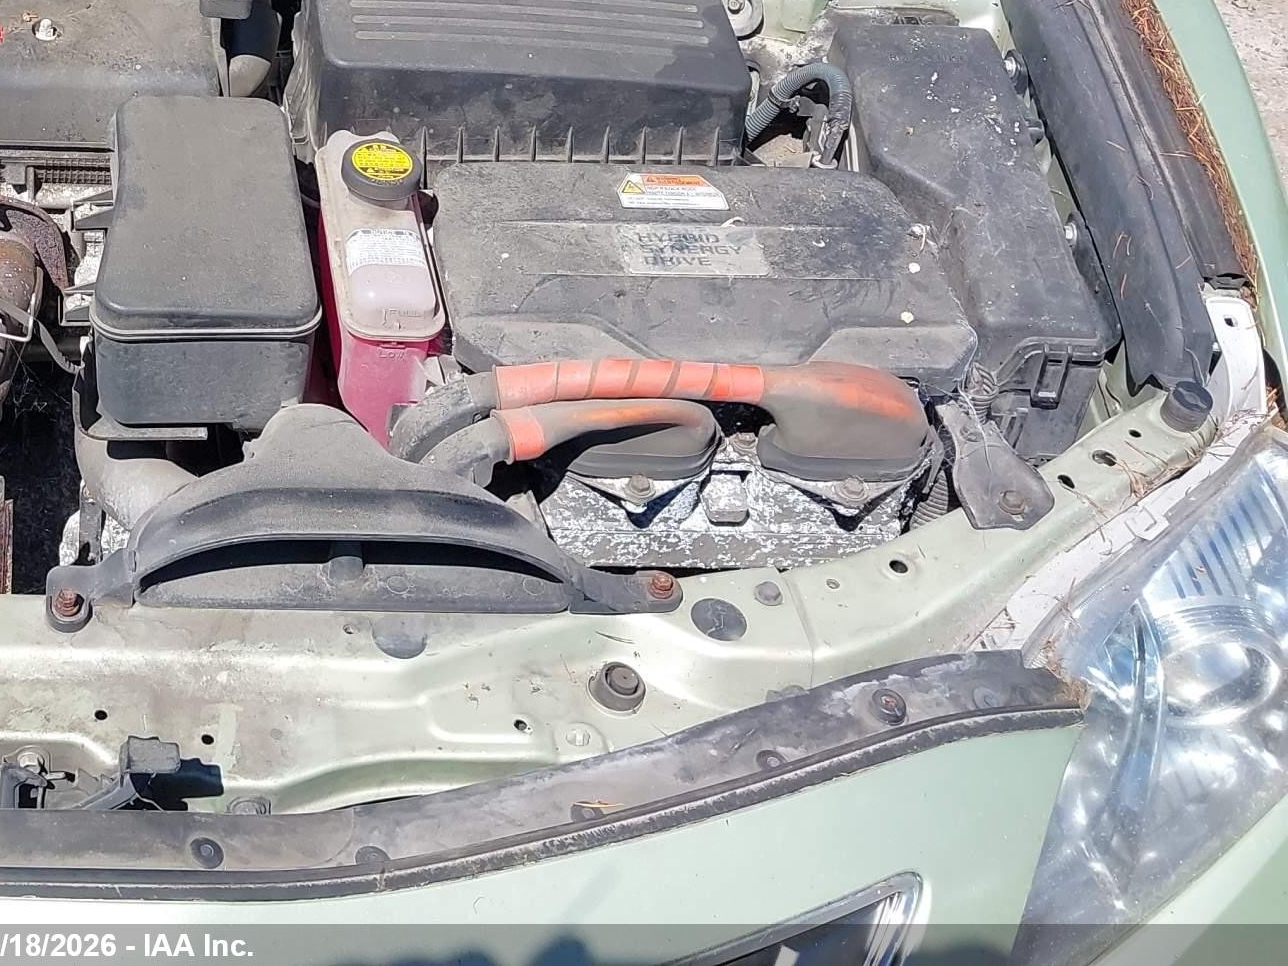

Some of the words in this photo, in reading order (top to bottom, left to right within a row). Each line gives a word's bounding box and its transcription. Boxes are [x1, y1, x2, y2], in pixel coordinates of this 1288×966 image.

[637, 232, 720, 244] HYBRID
[639, 244, 742, 255] SYNERGY
[643, 256, 713, 267] DRIVE
